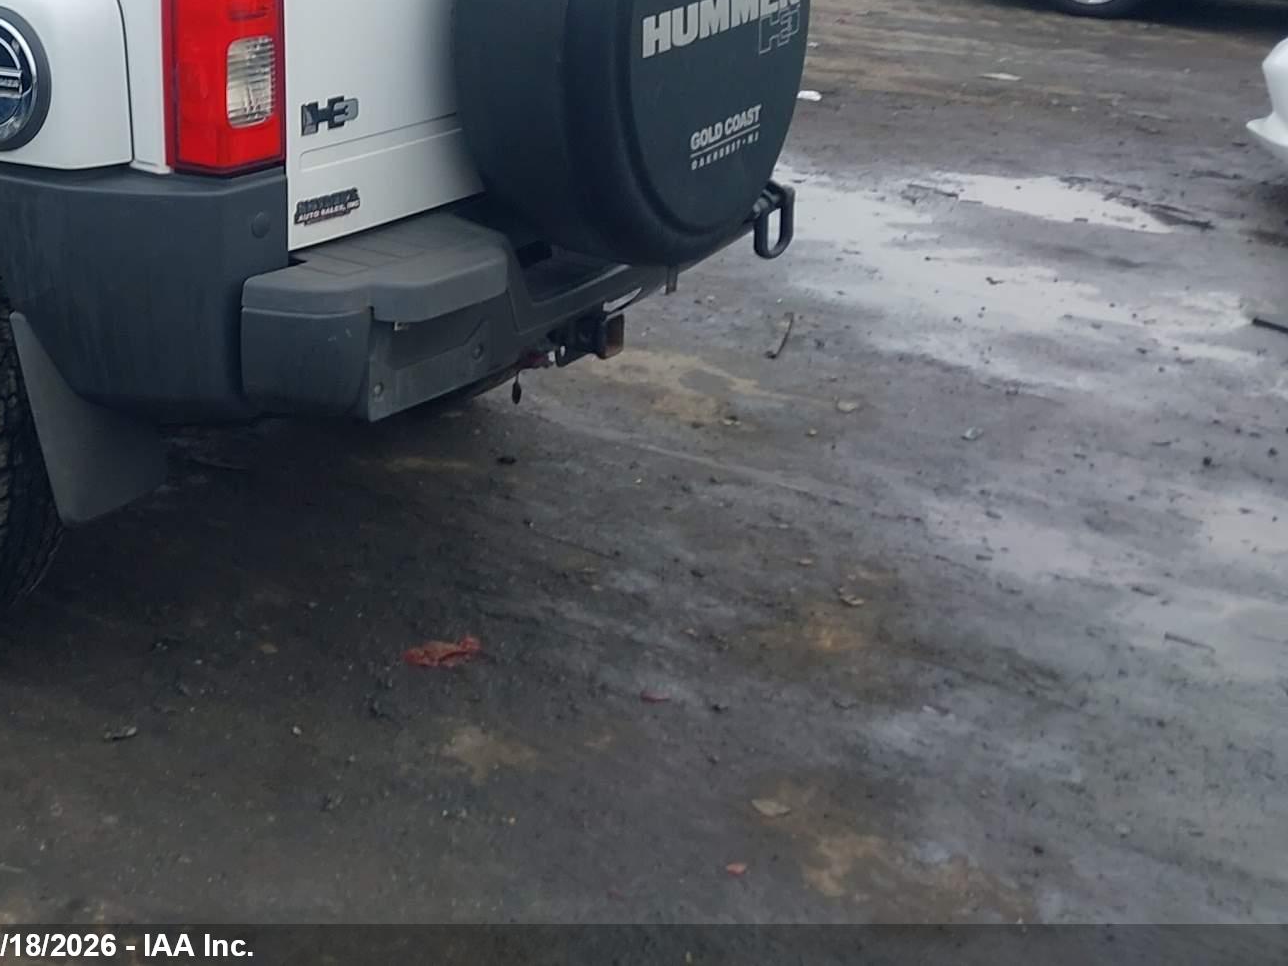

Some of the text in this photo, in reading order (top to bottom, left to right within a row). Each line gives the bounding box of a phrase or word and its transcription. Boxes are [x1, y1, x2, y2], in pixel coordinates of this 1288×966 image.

[300, 95, 359, 137] H3
[691, 104, 762, 150] GOLD COAST
